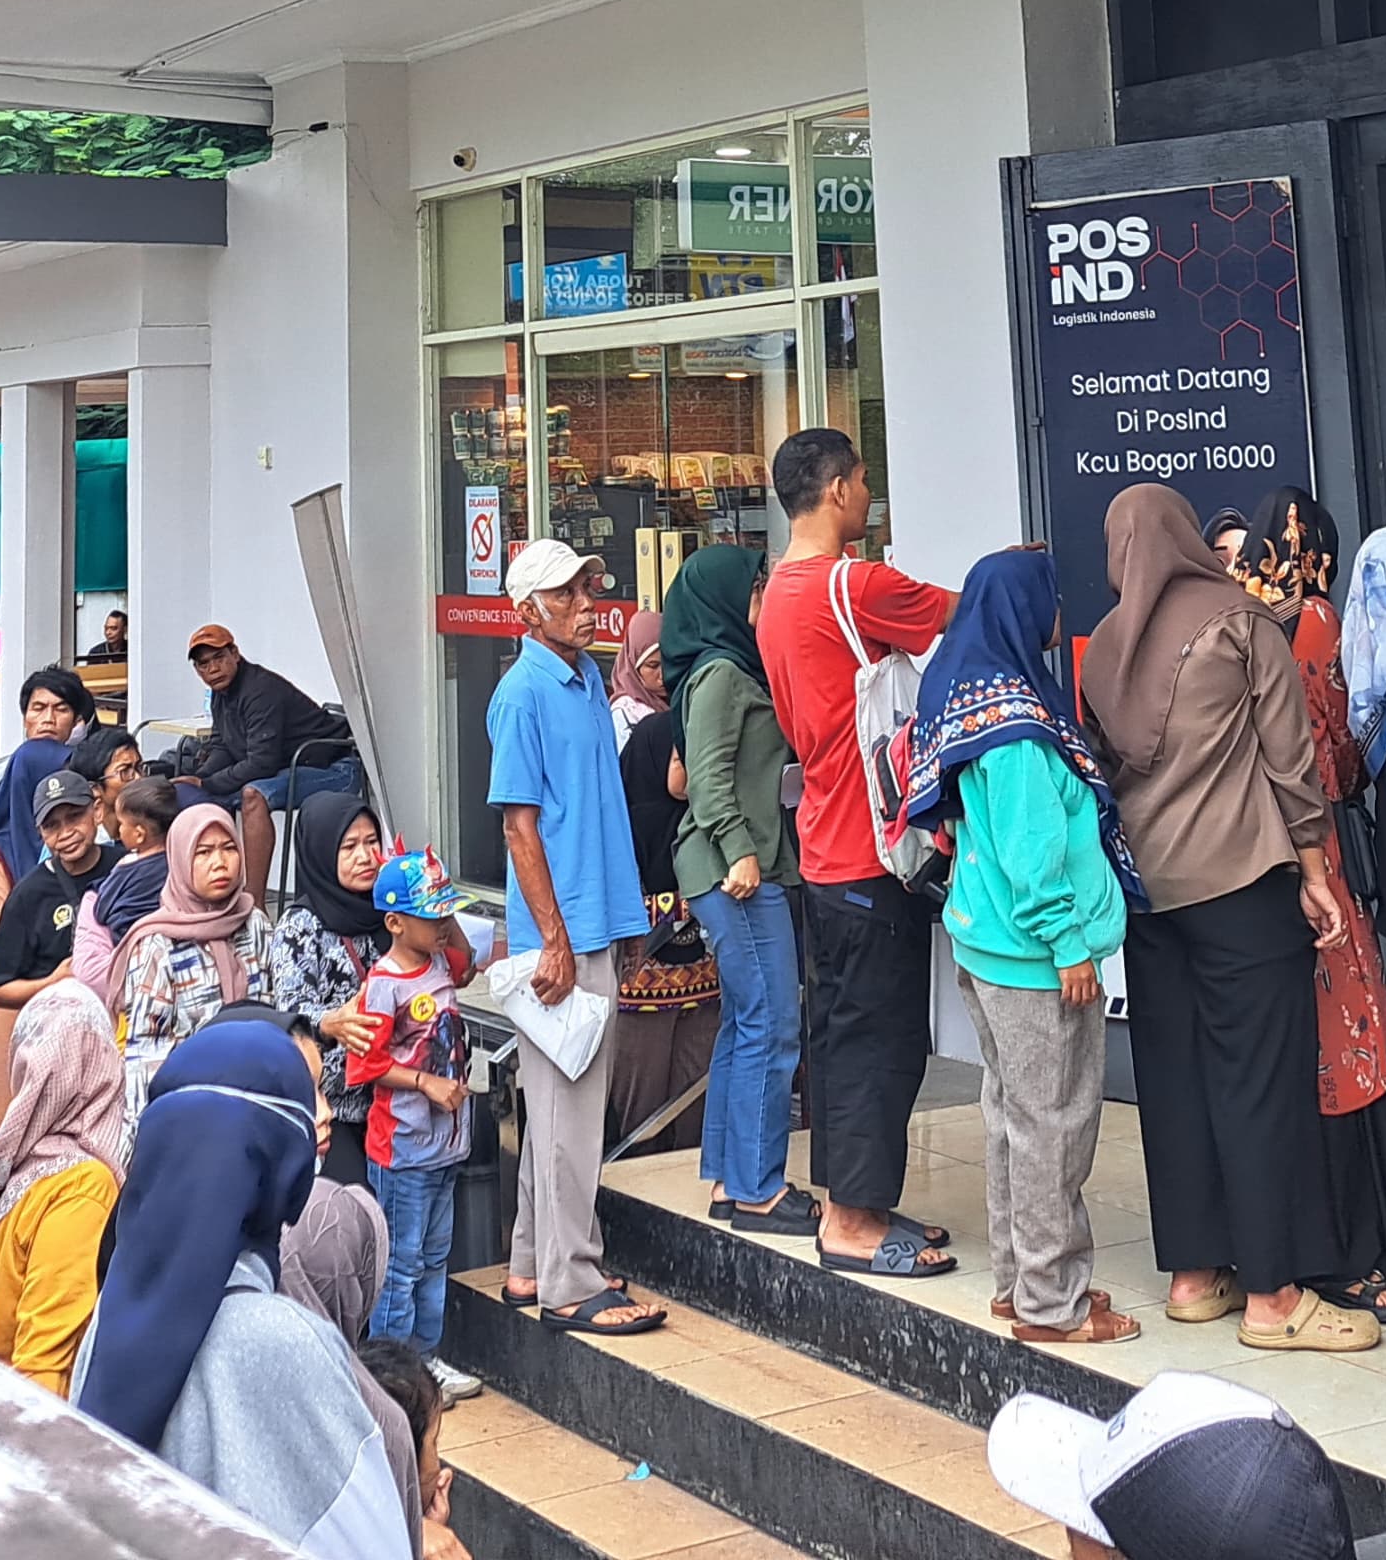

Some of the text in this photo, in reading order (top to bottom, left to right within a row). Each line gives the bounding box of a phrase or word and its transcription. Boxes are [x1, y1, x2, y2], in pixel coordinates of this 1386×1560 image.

[1047, 216, 1151, 264] POS
[585, 274, 645, 289] ABOUT
[595, 293, 619, 307] OF
[621, 292, 684, 307] COFFEE
[1053, 308, 1157, 327] Logistik Indonesia
[1072, 367, 1271, 396] Selamat Datang
[1116, 405, 1227, 433] Di PosInd
[1076, 444, 1276, 478] Kcu Bogor 16000
[447, 608, 500, 623] CONVENIENCE
[501, 610, 524, 624] STOR
